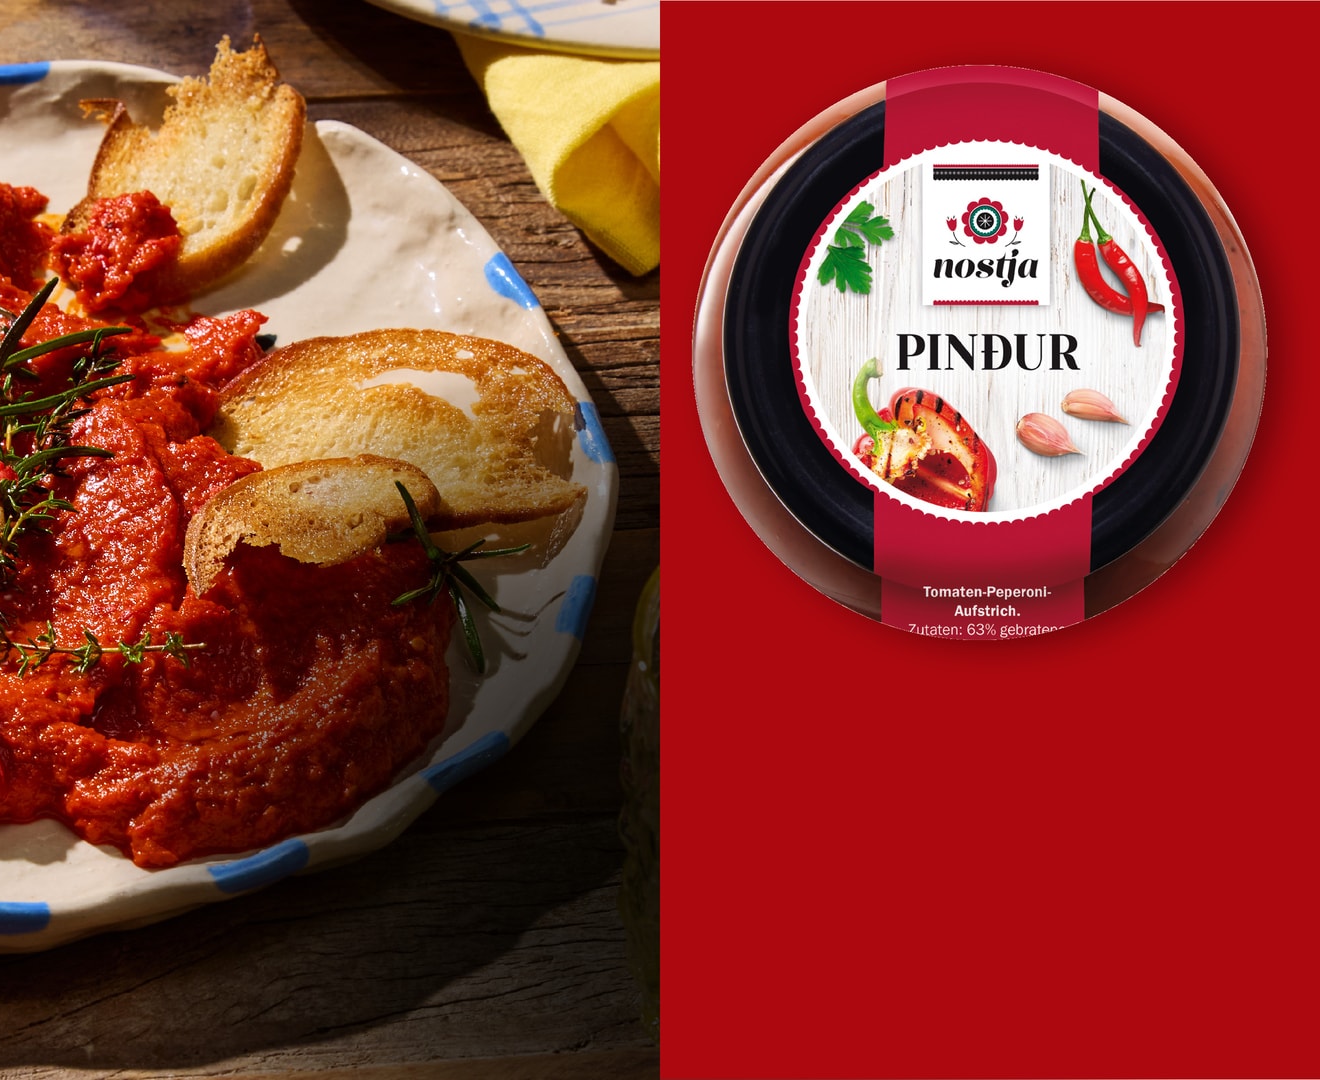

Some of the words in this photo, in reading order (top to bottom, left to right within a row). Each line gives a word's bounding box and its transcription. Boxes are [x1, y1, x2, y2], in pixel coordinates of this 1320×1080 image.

[933, 248, 1039, 288] nostja
[923, 585, 1052, 600] Tomaten-Peperoni-
[954, 604, 1021, 617] Aufstrich.
[908, 623, 963, 636] Zutaten:
[966, 623, 997, 636] 63%
